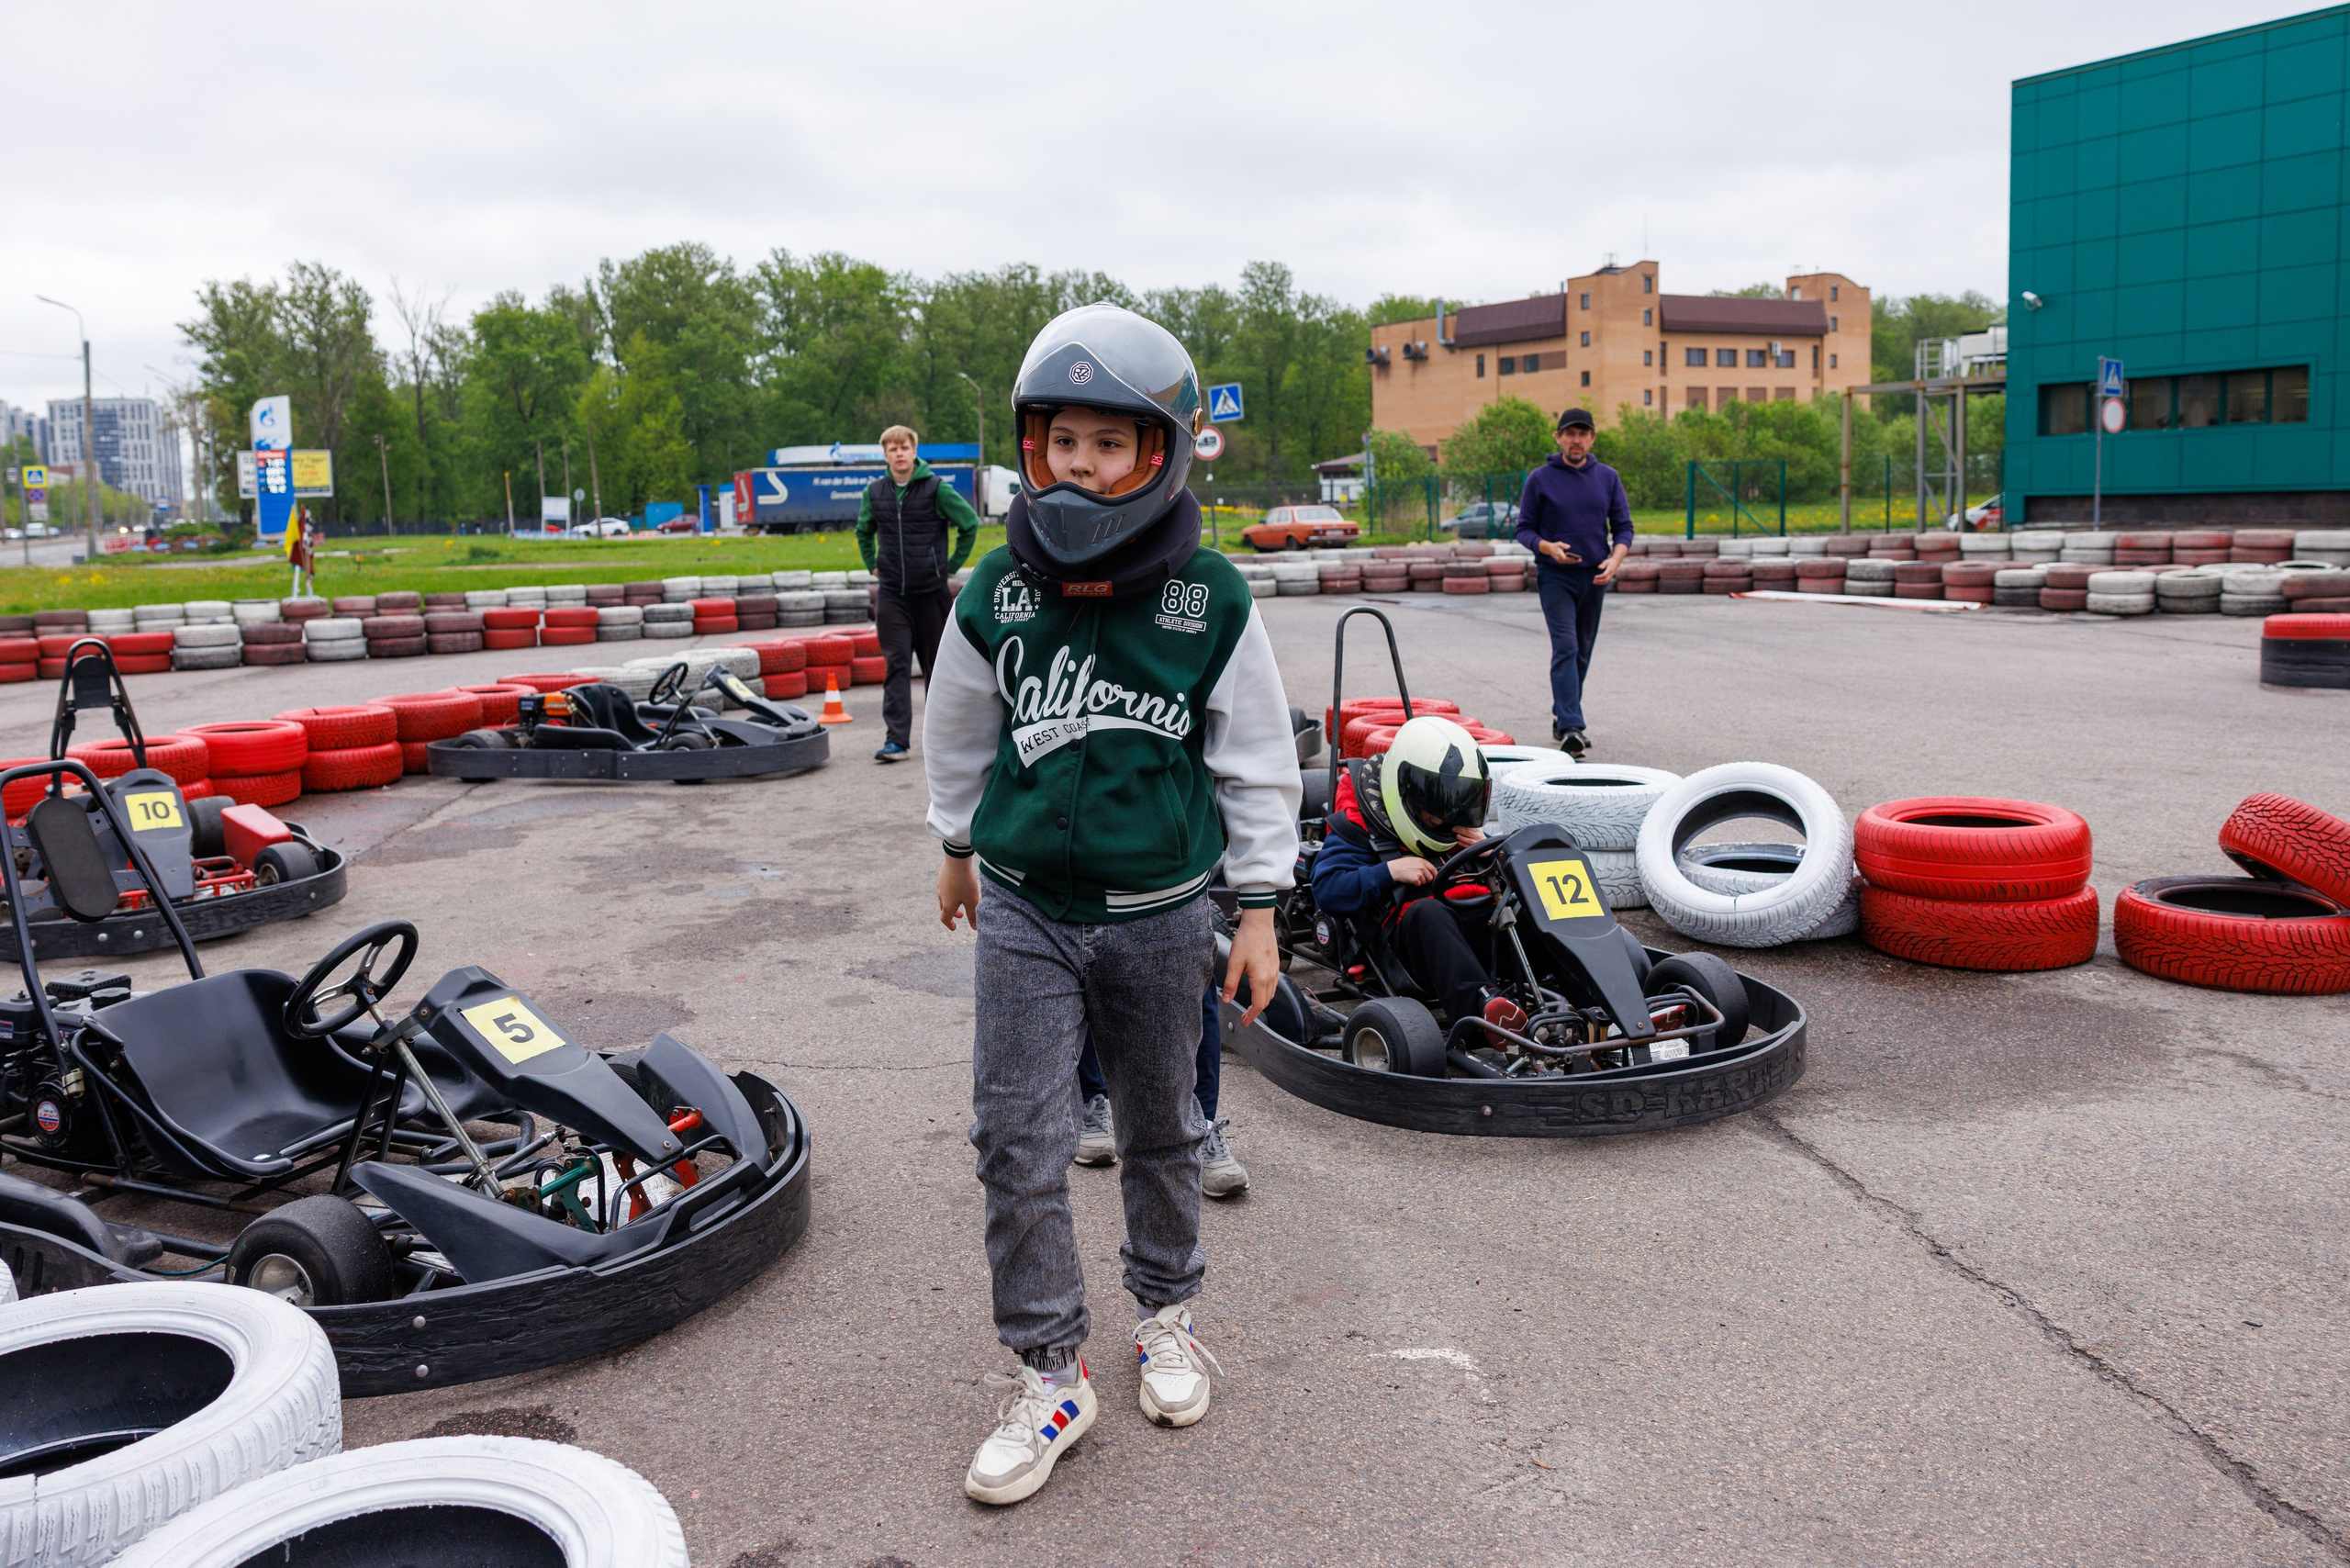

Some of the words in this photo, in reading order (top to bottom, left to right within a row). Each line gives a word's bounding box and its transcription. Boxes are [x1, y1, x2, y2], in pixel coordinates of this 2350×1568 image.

[1001, 587, 1034, 612] LA
[1067, 584, 1108, 593] RLG
[1161, 578, 1209, 618] 88
[994, 611, 1035, 620] CALIFORNIA
[1158, 617, 1183, 626] ATHLETIC
[1183, 621, 1203, 629] DIVISION
[995, 635, 1192, 738] California
[1020, 726, 1060, 755] WEST
[1062, 717, 1091, 734] COAST
[138, 801, 170, 820] 10
[1546, 874, 1590, 905] 12
[492, 1013, 535, 1043] 5
